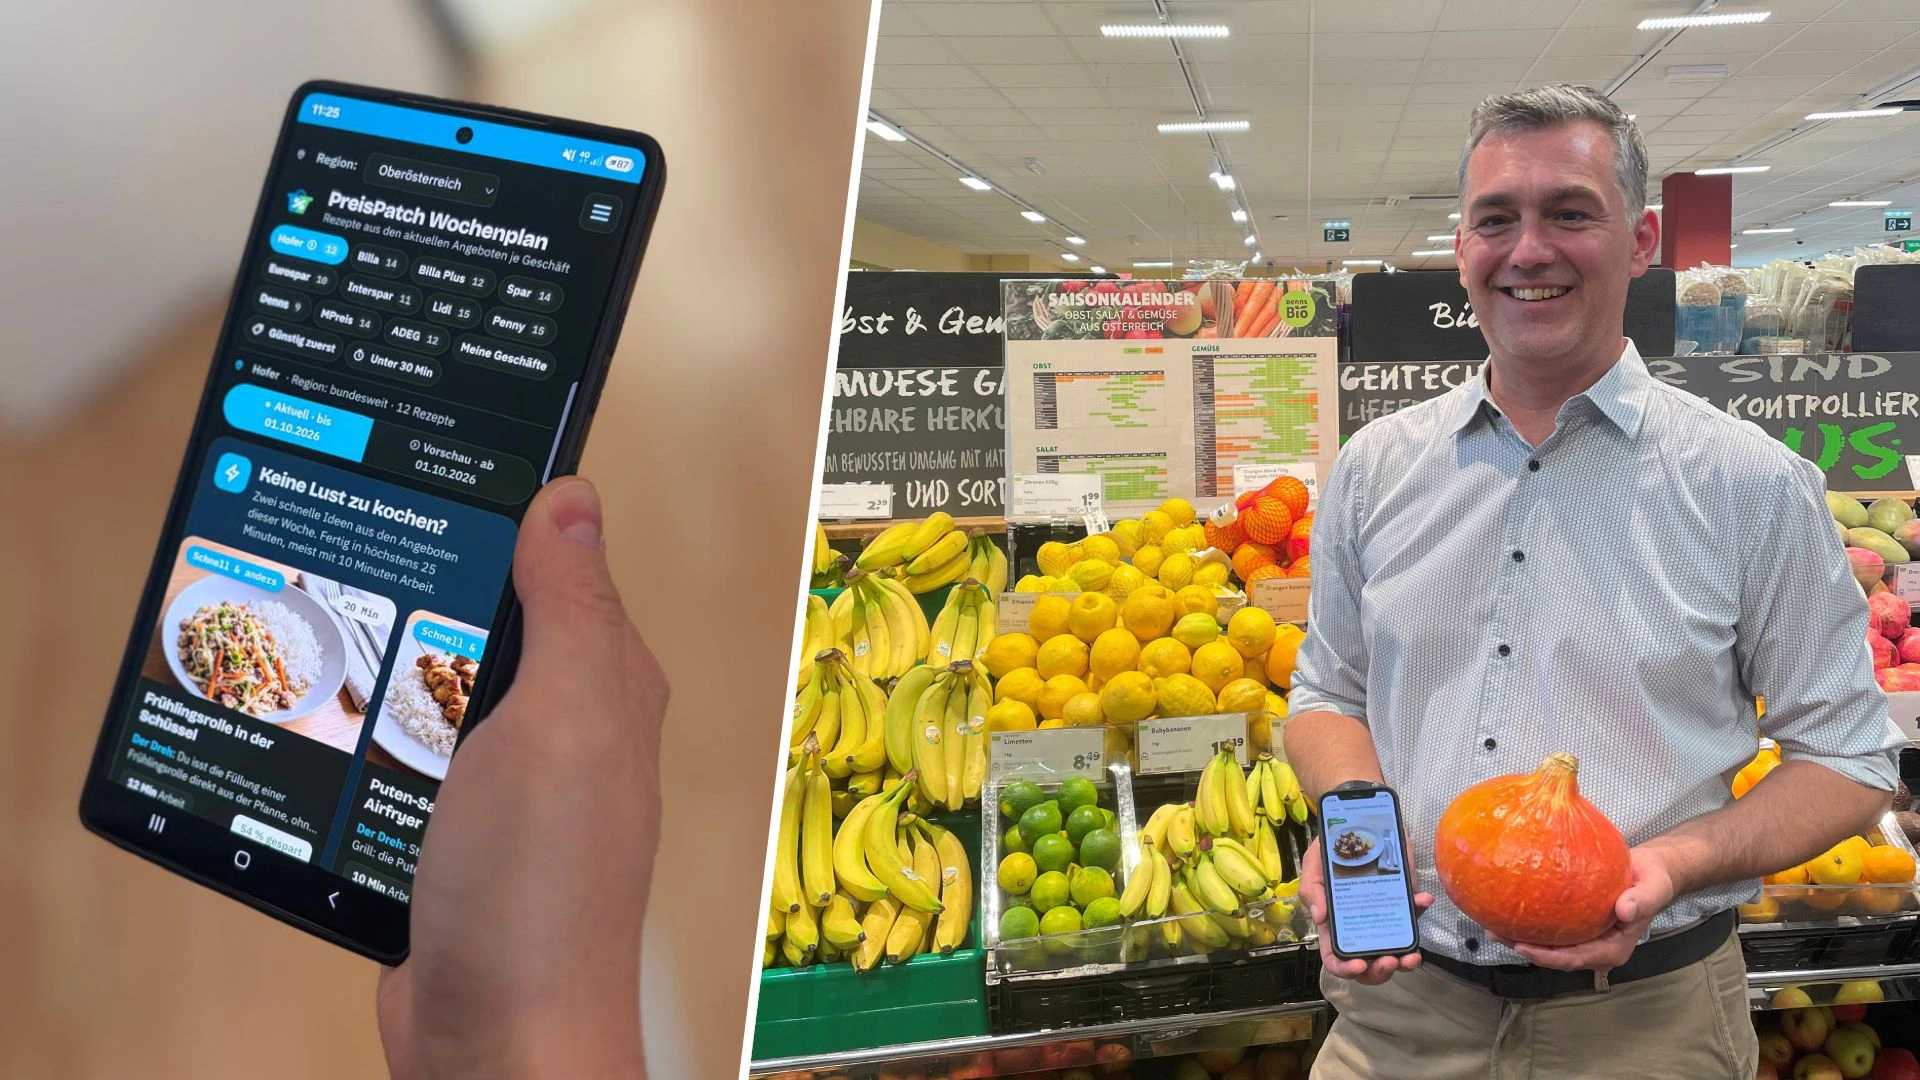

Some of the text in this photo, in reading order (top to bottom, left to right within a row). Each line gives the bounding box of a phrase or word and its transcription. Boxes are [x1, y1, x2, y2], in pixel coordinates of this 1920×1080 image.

[312, 104, 340, 118] 11:25
[316, 152, 358, 170] Region:
[379, 165, 462, 191] Oberösterreich
[328, 190, 549, 251] PreisPatch Wochenplan
[278, 234, 338, 254] Hofer 12
[323, 212, 570, 274] Rezepte aus den aktuellen Angeboten je Geschäft
[357, 251, 397, 268] Billa 14
[268, 263, 312, 281] Eurospar
[418, 264, 484, 288] Billa Plus 12
[259, 292, 290, 310] Denns
[347, 282, 411, 306] Interspar 11
[506, 284, 552, 302] Spar 14
[1048, 292, 1195, 306] SAISONKALENDER
[320, 308, 371, 328] MPreis 14
[432, 300, 470, 319] Lidl 15
[906, 306, 928, 335] &
[1064, 308, 1178, 320] OBST, SALAT & GEMÜSE
[391, 326, 439, 346] ADEG 12
[492, 316, 544, 336] Penny 15
[1080, 320, 1164, 332] AUS ÖSTERREICH
[268, 327, 336, 354] Günstig zuerst
[370, 354, 434, 378] Unter 30 Min
[460, 342, 548, 372] Meine Geschäfte
[1719, 354, 1892, 382] SIND
[252, 363, 456, 428] Hofer Region: bundesweit 12 Rezepte
[274, 402, 332, 426] Aktuell bis
[264, 417, 320, 441] 01.10.2026
[424, 442, 494, 471] Vorschau ab
[842, 452, 906, 474] BEWUSSTEN
[910, 450, 956, 470] UMGANG
[415, 460, 477, 485] 01.10.2026
[259, 466, 448, 535] Keine Lust zu kochen?
[867, 500, 888, 510] 2,39
[906, 479, 950, 508] UND
[1082, 492, 1099, 506] 1,99
[252, 491, 459, 563] Zwei schnelle Ideen aus den Angeboten
[248, 508, 436, 576] dieser Woche. Fertig in höchstens 25
[192, 551, 278, 586] Schnell & anders
[243, 524, 436, 595] Minuten, meist mit 10 Minuten Arbeit.
[344, 602, 379, 620] 20 Min
[421, 626, 476, 653] Schnell &
[139, 709, 198, 741] Schüssel
[143, 691, 274, 750] Frühlingsrolle in der
[131, 733, 286, 803] Der Dreh: Du isst die Füllung einer
[1073, 752, 1100, 770] 8,49
[126, 748, 189, 782] Frühlingsrolle
[189, 774, 216, 792] direkt
[217, 786, 234, 800] aus
[236, 791, 252, 807] der
[253, 798, 289, 823] Pfanne,
[157, 790, 185, 808] Arbeit
[364, 798, 424, 830] Airfryer
[240, 824, 303, 857] 54 % gespart
[356, 822, 376, 838] Der
[377, 831, 406, 851] Dreh:
[352, 840, 376, 858] Grill:
[378, 850, 394, 864] die
[352, 871, 366, 884] 10
[366, 878, 386, 894] Min
